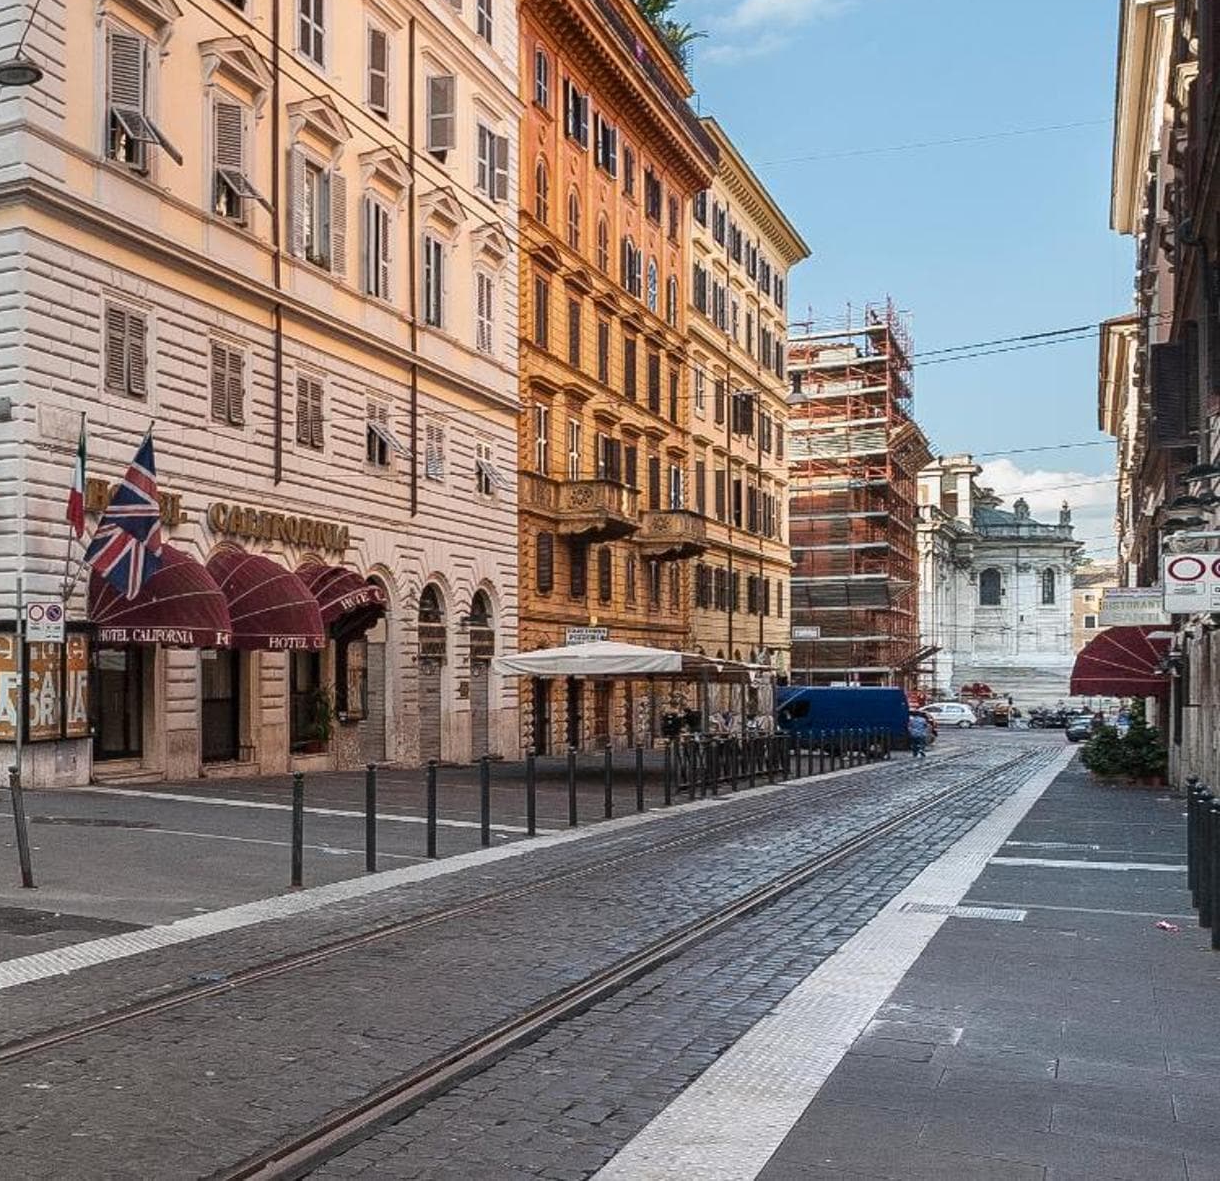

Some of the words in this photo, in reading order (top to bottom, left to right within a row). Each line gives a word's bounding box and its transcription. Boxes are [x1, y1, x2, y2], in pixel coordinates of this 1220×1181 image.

[207, 502, 351, 554] CALIFORNIA
[99, 629, 129, 642] HOTEL
[132, 628, 194, 644] CALIFORNIA
[269, 636, 309, 648] HOTEL
